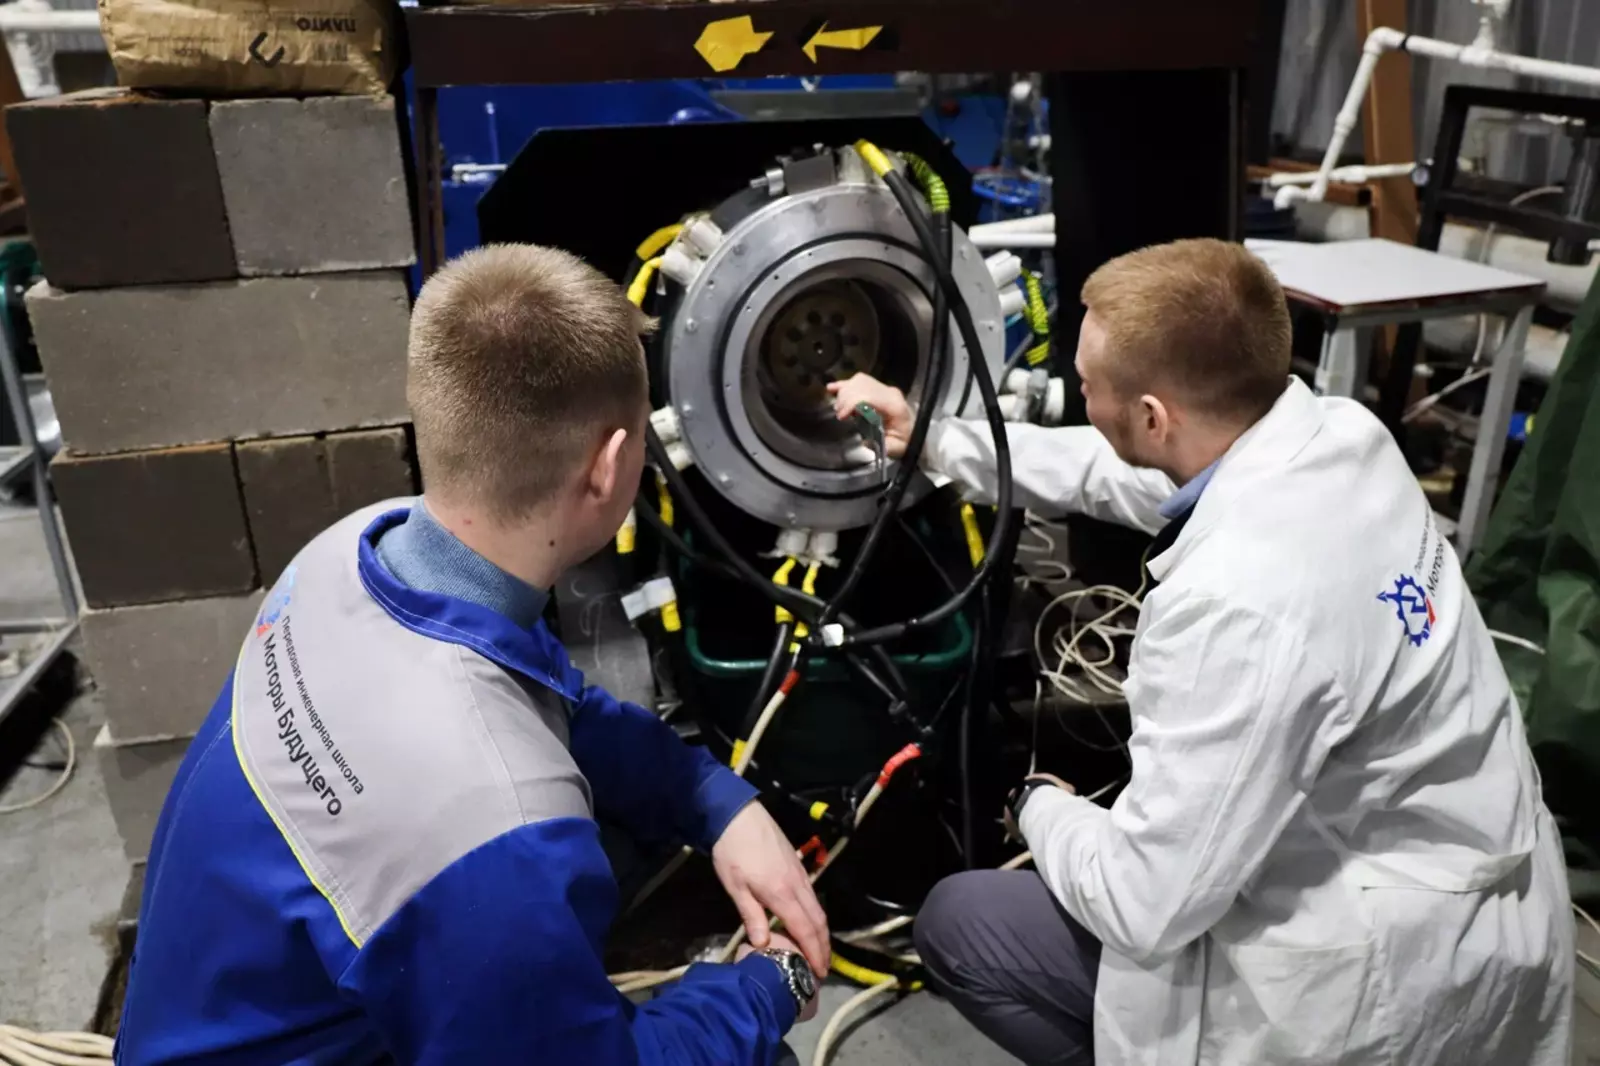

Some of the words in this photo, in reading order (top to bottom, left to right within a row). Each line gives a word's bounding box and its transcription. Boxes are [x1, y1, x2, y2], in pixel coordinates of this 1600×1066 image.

[264, 633, 286, 713] Моторы
[278, 707, 342, 816] Будущего
[282, 615, 302, 680] Передовая
[296, 677, 335, 751] инженерная
[332, 749, 365, 795] школа
